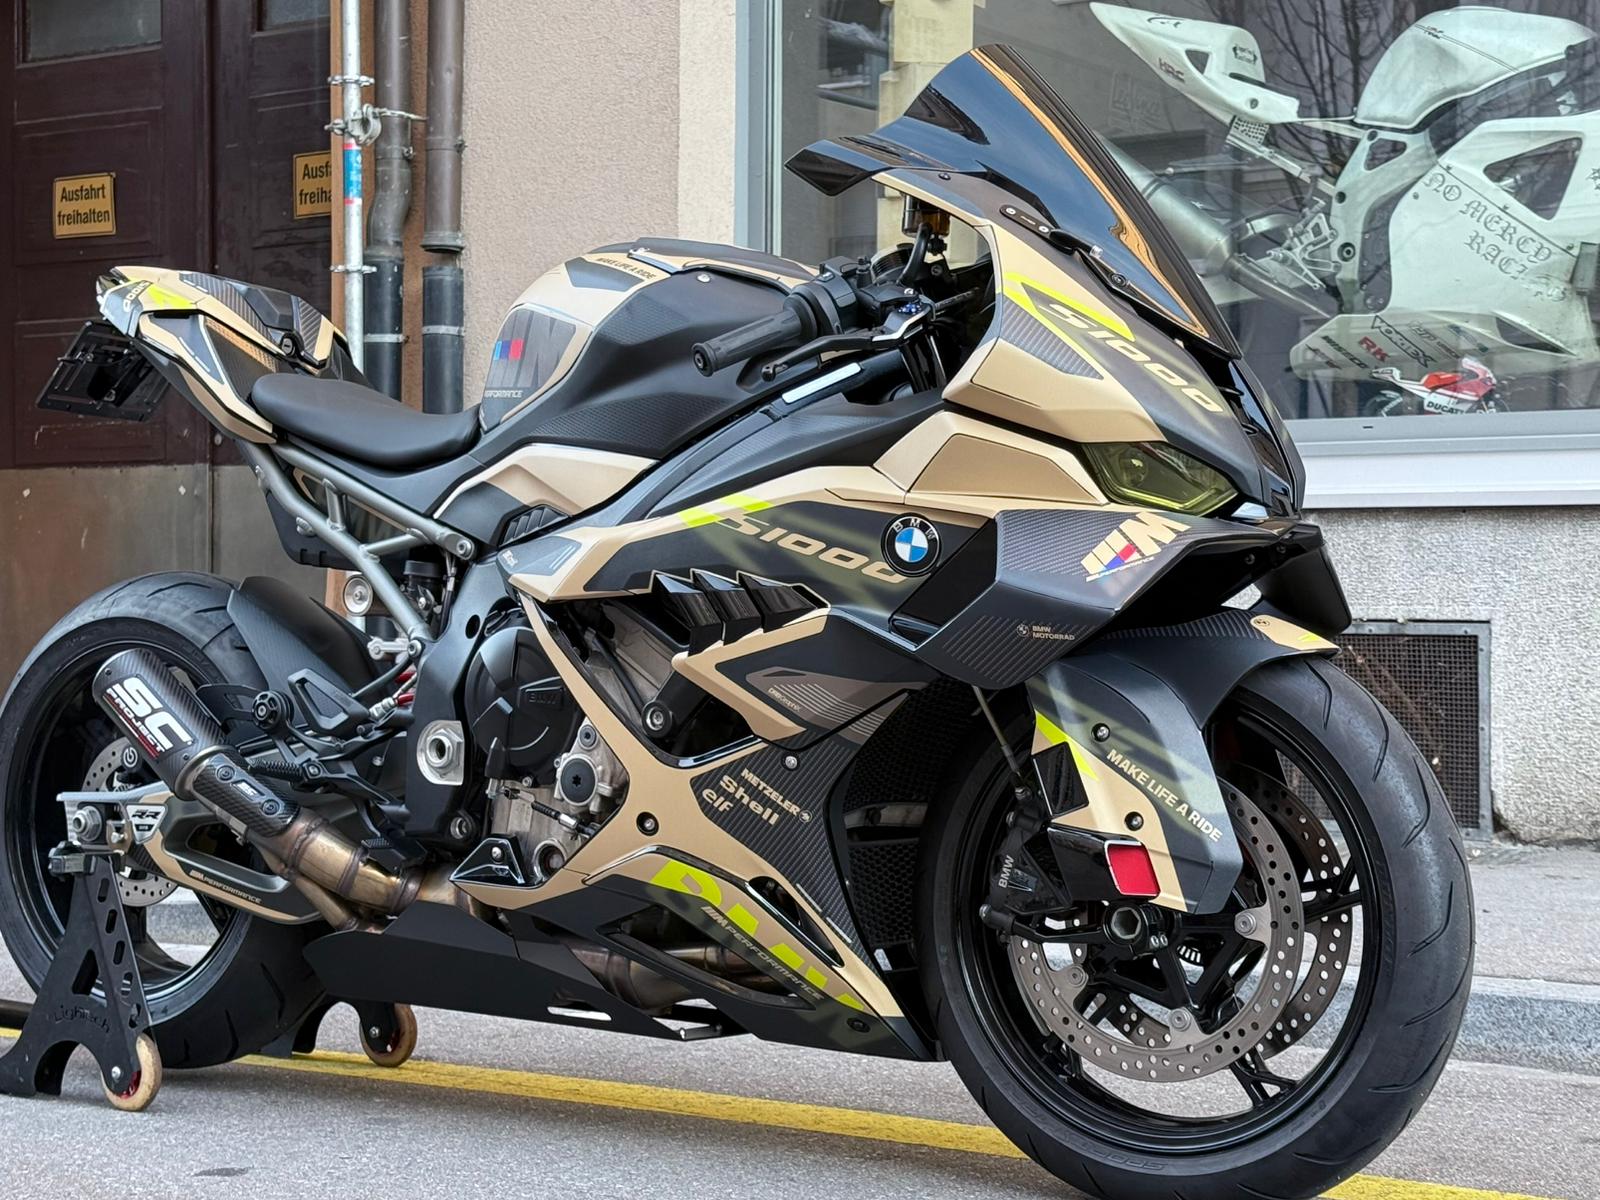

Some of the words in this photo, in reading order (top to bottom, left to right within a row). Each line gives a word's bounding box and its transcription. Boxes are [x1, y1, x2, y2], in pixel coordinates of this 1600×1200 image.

[302, 160, 332, 180] Ausf
[60, 184, 106, 203] Ausfahrt
[1423, 172, 1462, 202] NO
[57, 208, 110, 227] freihalten
[1037, 303, 1224, 412] S1000
[1032, 625, 1051, 633] BMW
[1032, 632, 1075, 641] MOTORRAD
[720, 775, 779, 825] Shell
[741, 768, 801, 816] METZELER
[1107, 749, 1149, 786] MAKE
[1147, 780, 1177, 808] LIFE
[1175, 804, 1190, 818] A
[1188, 811, 1223, 843] RIDE
[998, 854, 1014, 888] BMW
[727, 923, 824, 1000] PERFORMANCE
